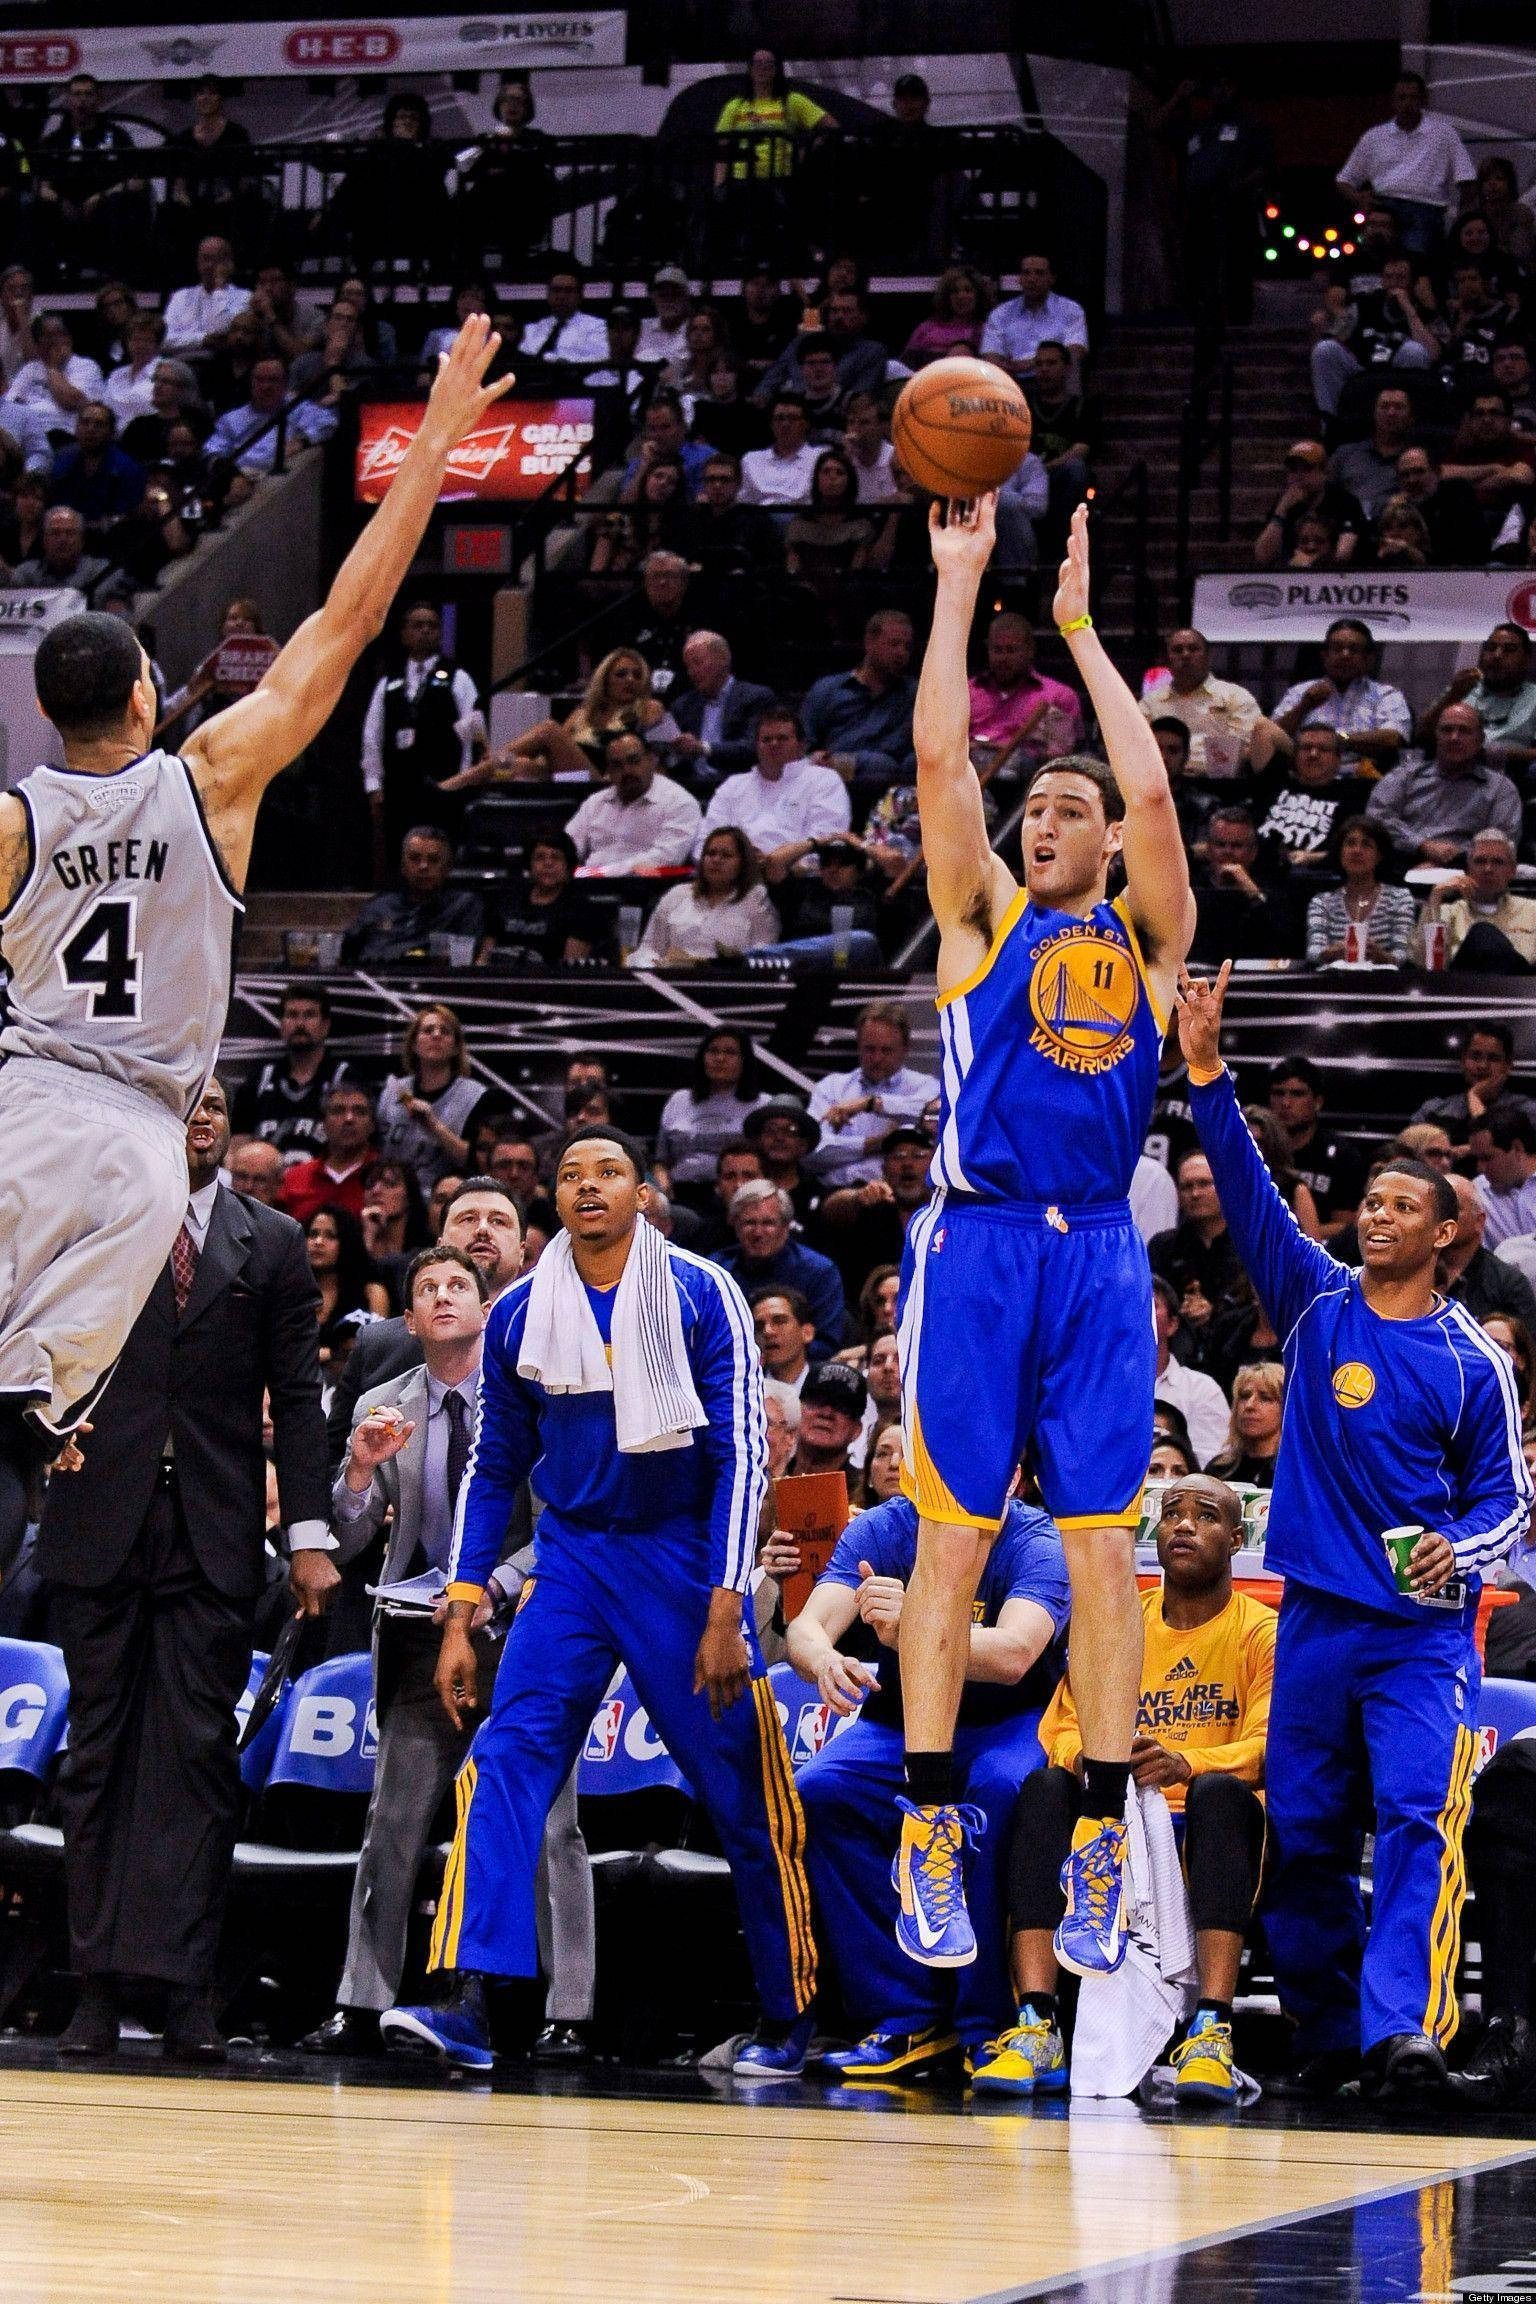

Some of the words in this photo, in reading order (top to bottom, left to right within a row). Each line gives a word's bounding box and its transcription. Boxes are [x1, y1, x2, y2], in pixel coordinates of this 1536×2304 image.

[0, 45, 69, 68] -E-B
[1287, 584, 1409, 605] PLAYOFFS
[52, 838, 169, 891] GREEN
[55, 895, 144, 1024] 4
[1029, 924, 1097, 961] GOLDEN
[1093, 959, 1116, 990] 11
[1028, 1025, 1136, 1076] WARRIORS
[1138, 1689, 1176, 1708] WE
[1180, 1683, 1224, 1704] ARE
[289, 1695, 357, 1758] B
[1135, 1700, 1240, 1730] ARRIORS
